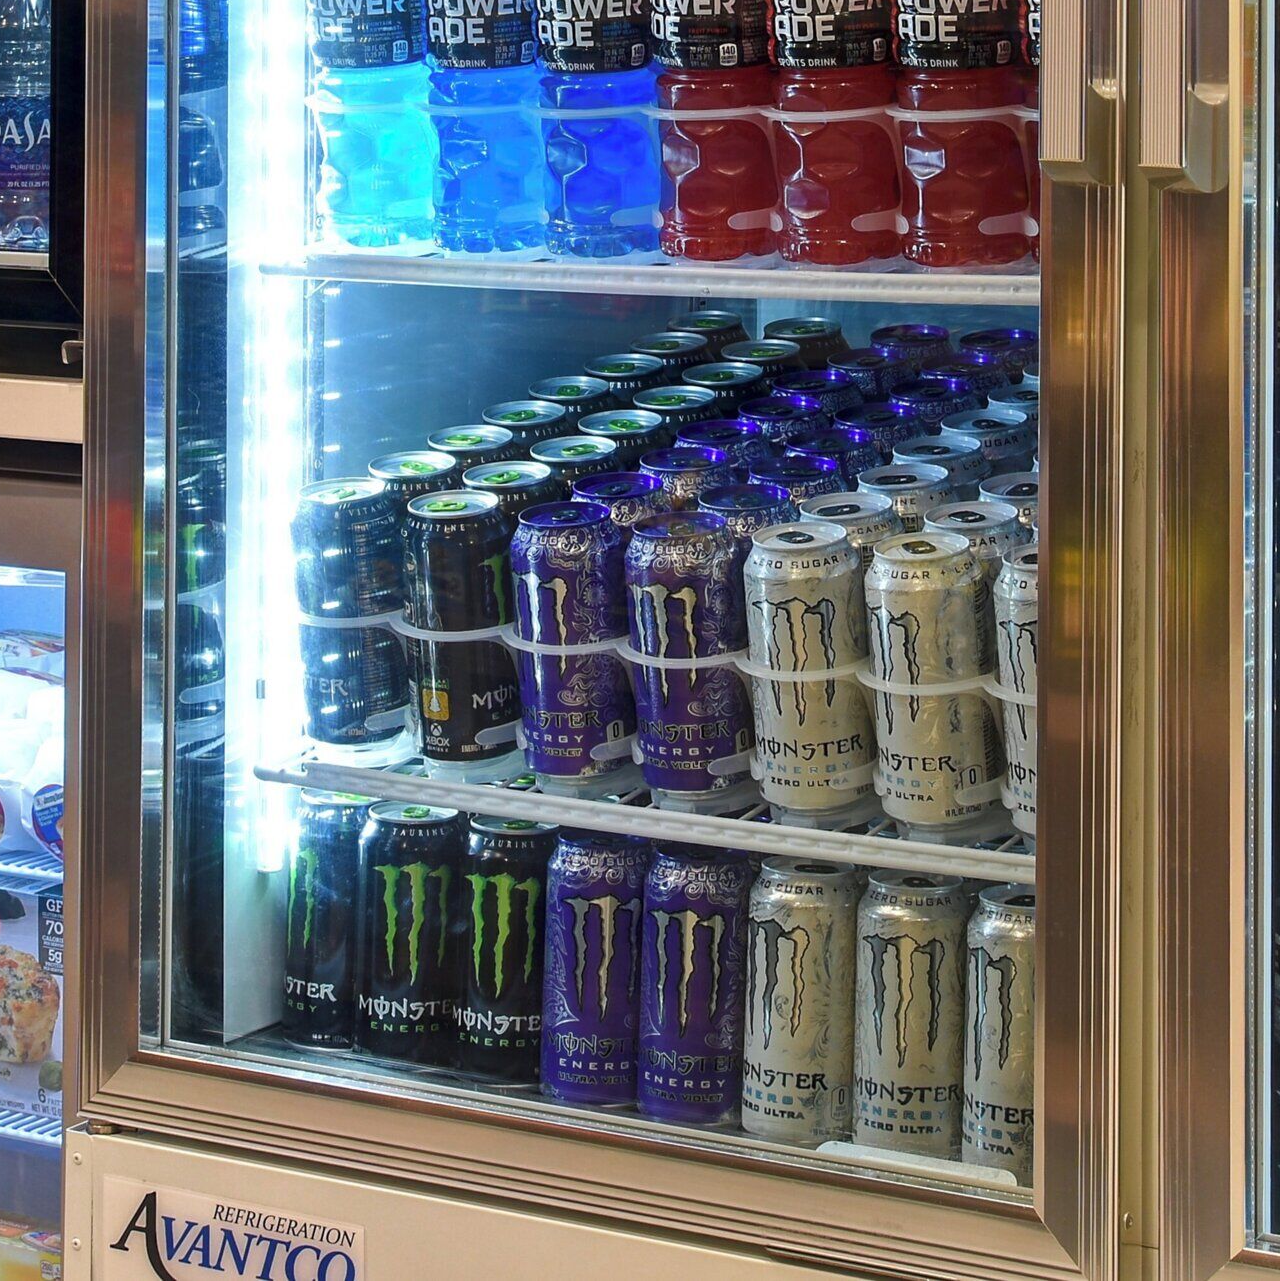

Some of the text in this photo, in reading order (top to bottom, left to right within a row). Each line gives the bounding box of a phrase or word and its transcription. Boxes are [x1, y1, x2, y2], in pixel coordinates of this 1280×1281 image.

[874, 39, 885, 48] 140
[426, 736, 450, 746] XBOX
[758, 733, 863, 760] MONSTER
[544, 747, 582, 757] VIOLET
[766, 760, 851, 775] ENERGY
[771, 776, 849, 787] ZERO ULTRA
[896, 791, 934, 802] ULTRA
[393, 827, 446, 837] TAURINE
[46, 920, 63, 935] 70
[48, 949, 61, 962] 5g
[645, 1071, 726, 1088] ENERGY
[38, 1089, 46, 1102] 6
[855, 1075, 962, 1104] MONSTER
[683, 1093, 723, 1102] VIOLET
[864, 1119, 942, 1134] ZERO ULTRA
[213, 1205, 355, 1248] REFRIGERATION
[110, 1191, 355, 1281] AVANTCO
